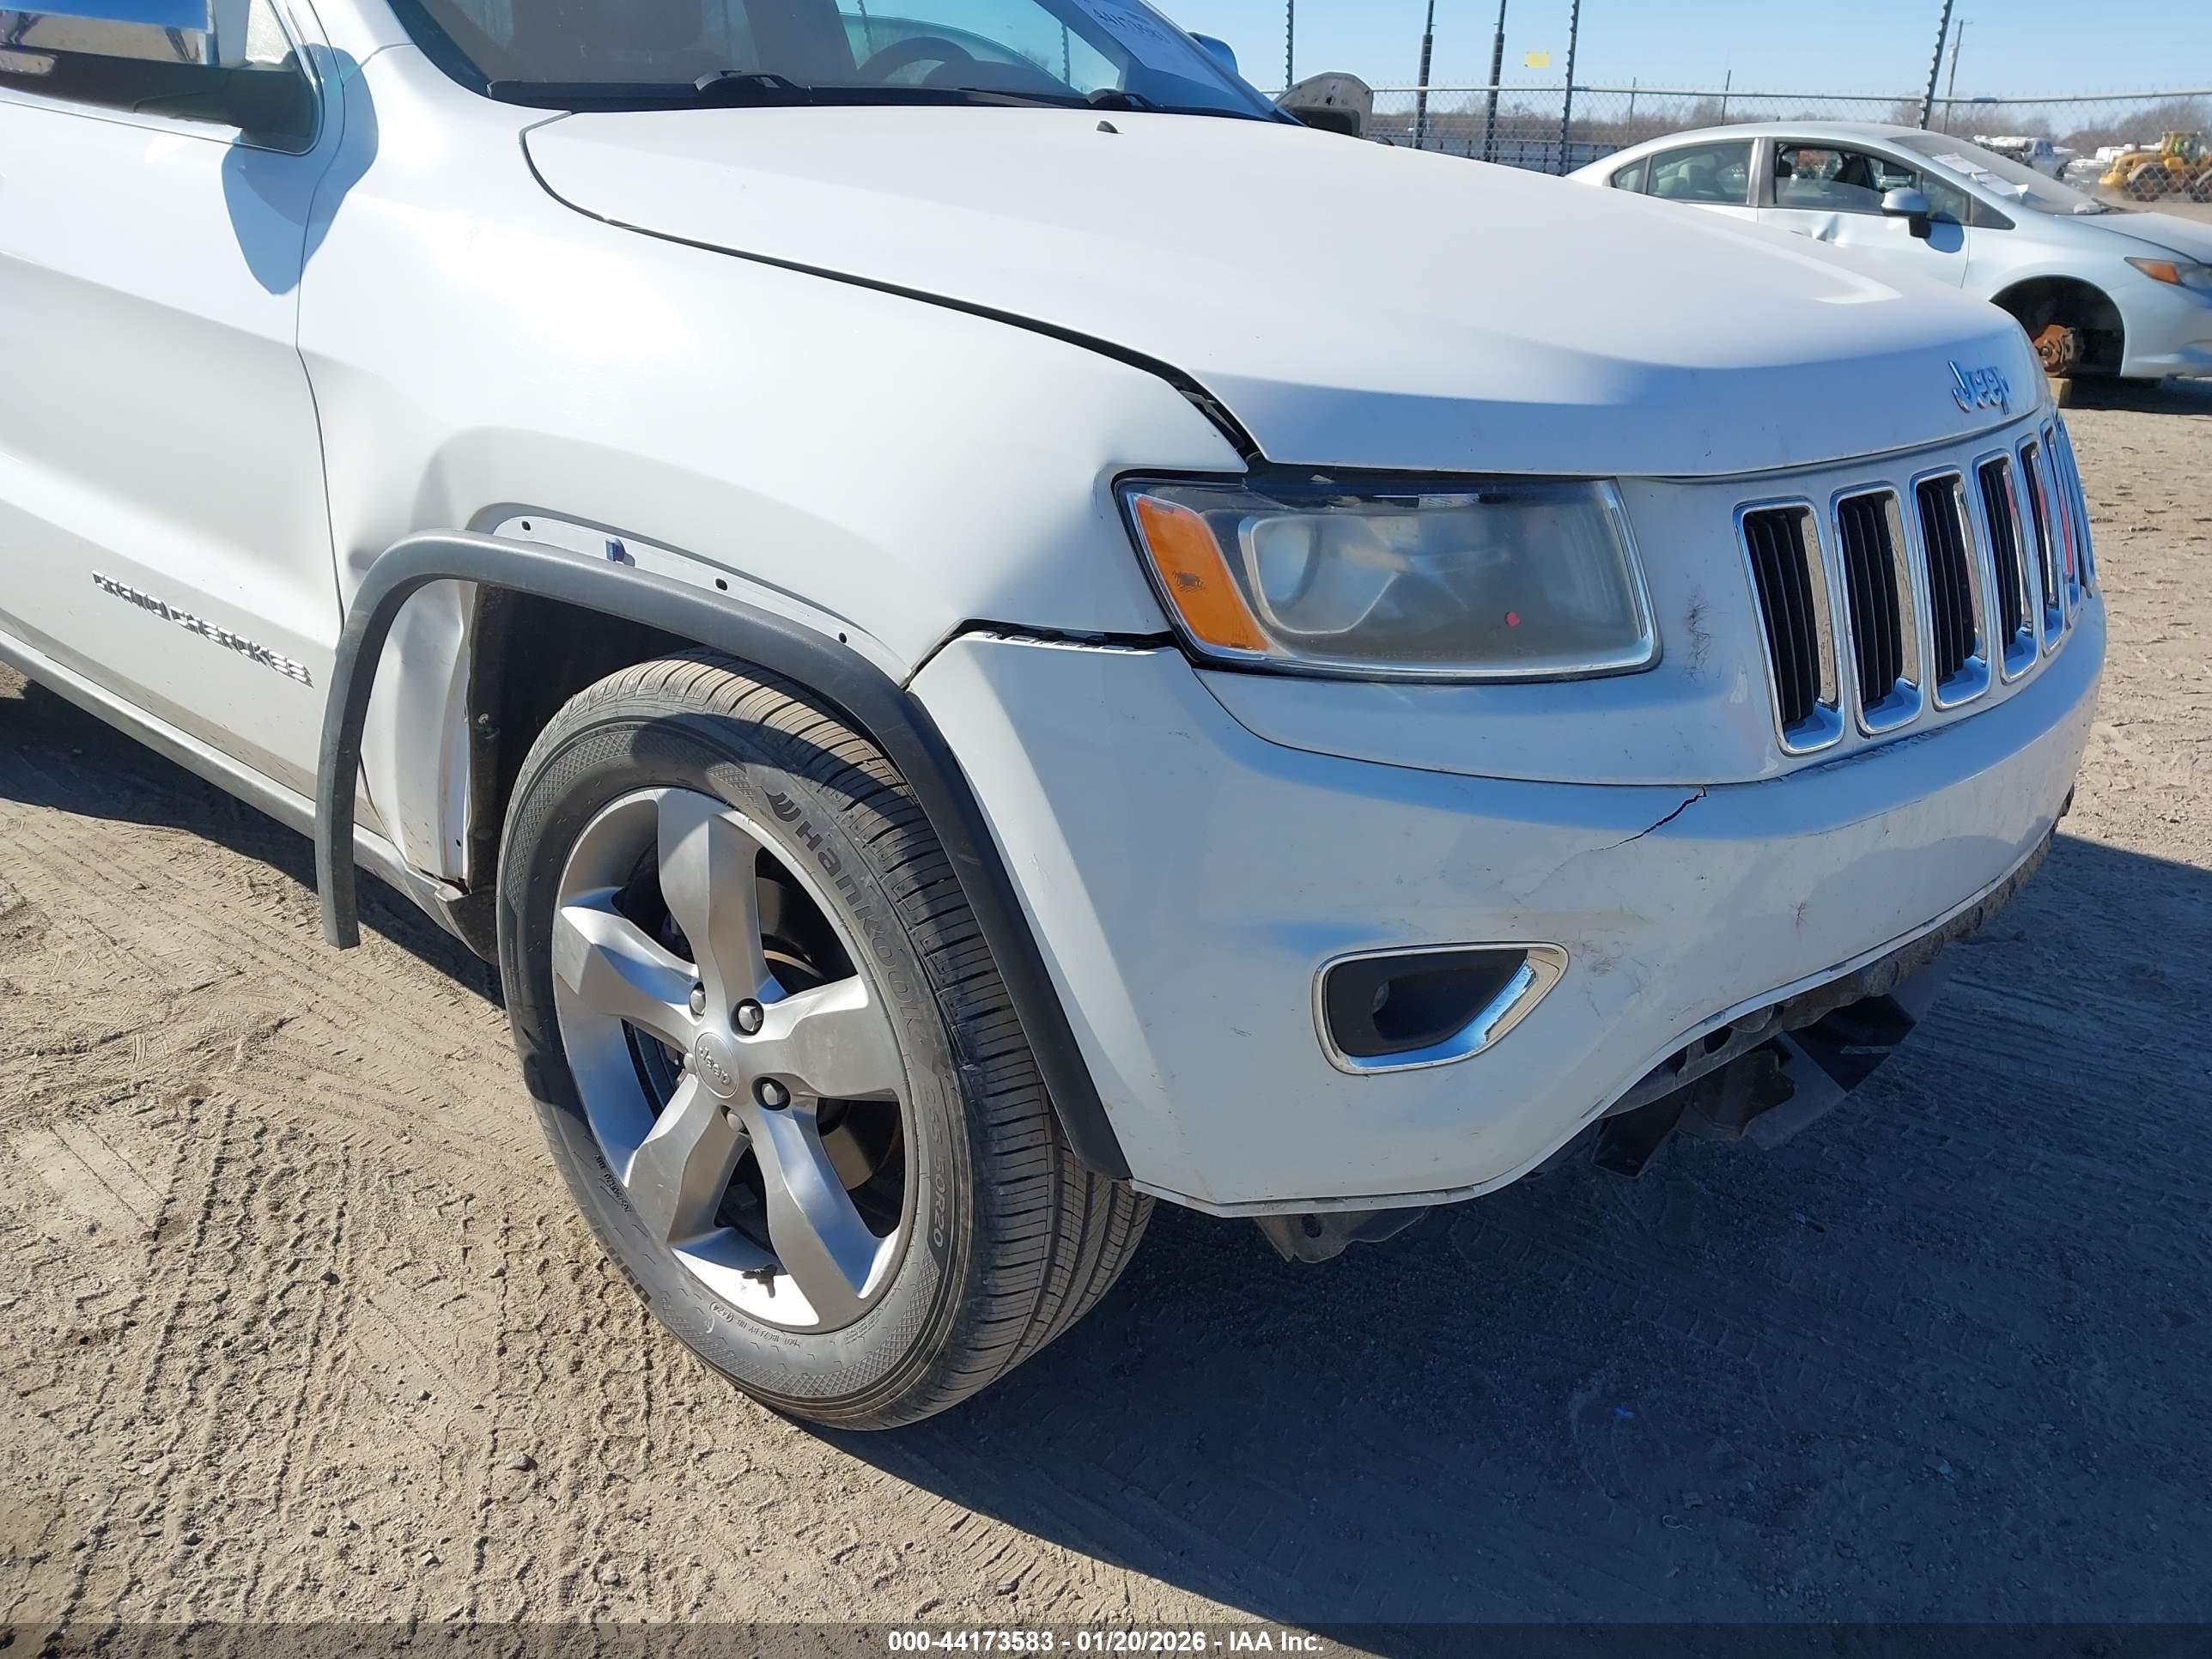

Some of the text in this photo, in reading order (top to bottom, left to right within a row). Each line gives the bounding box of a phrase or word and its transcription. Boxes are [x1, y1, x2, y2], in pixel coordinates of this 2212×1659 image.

[1948, 360, 2010, 415] Jeep
[91, 569, 315, 689] GRAND CHEROKEE
[795, 820, 922, 1036] Hankook
[697, 1045, 732, 1087] Jeep
[933, 1153, 946, 1248] 50R20
